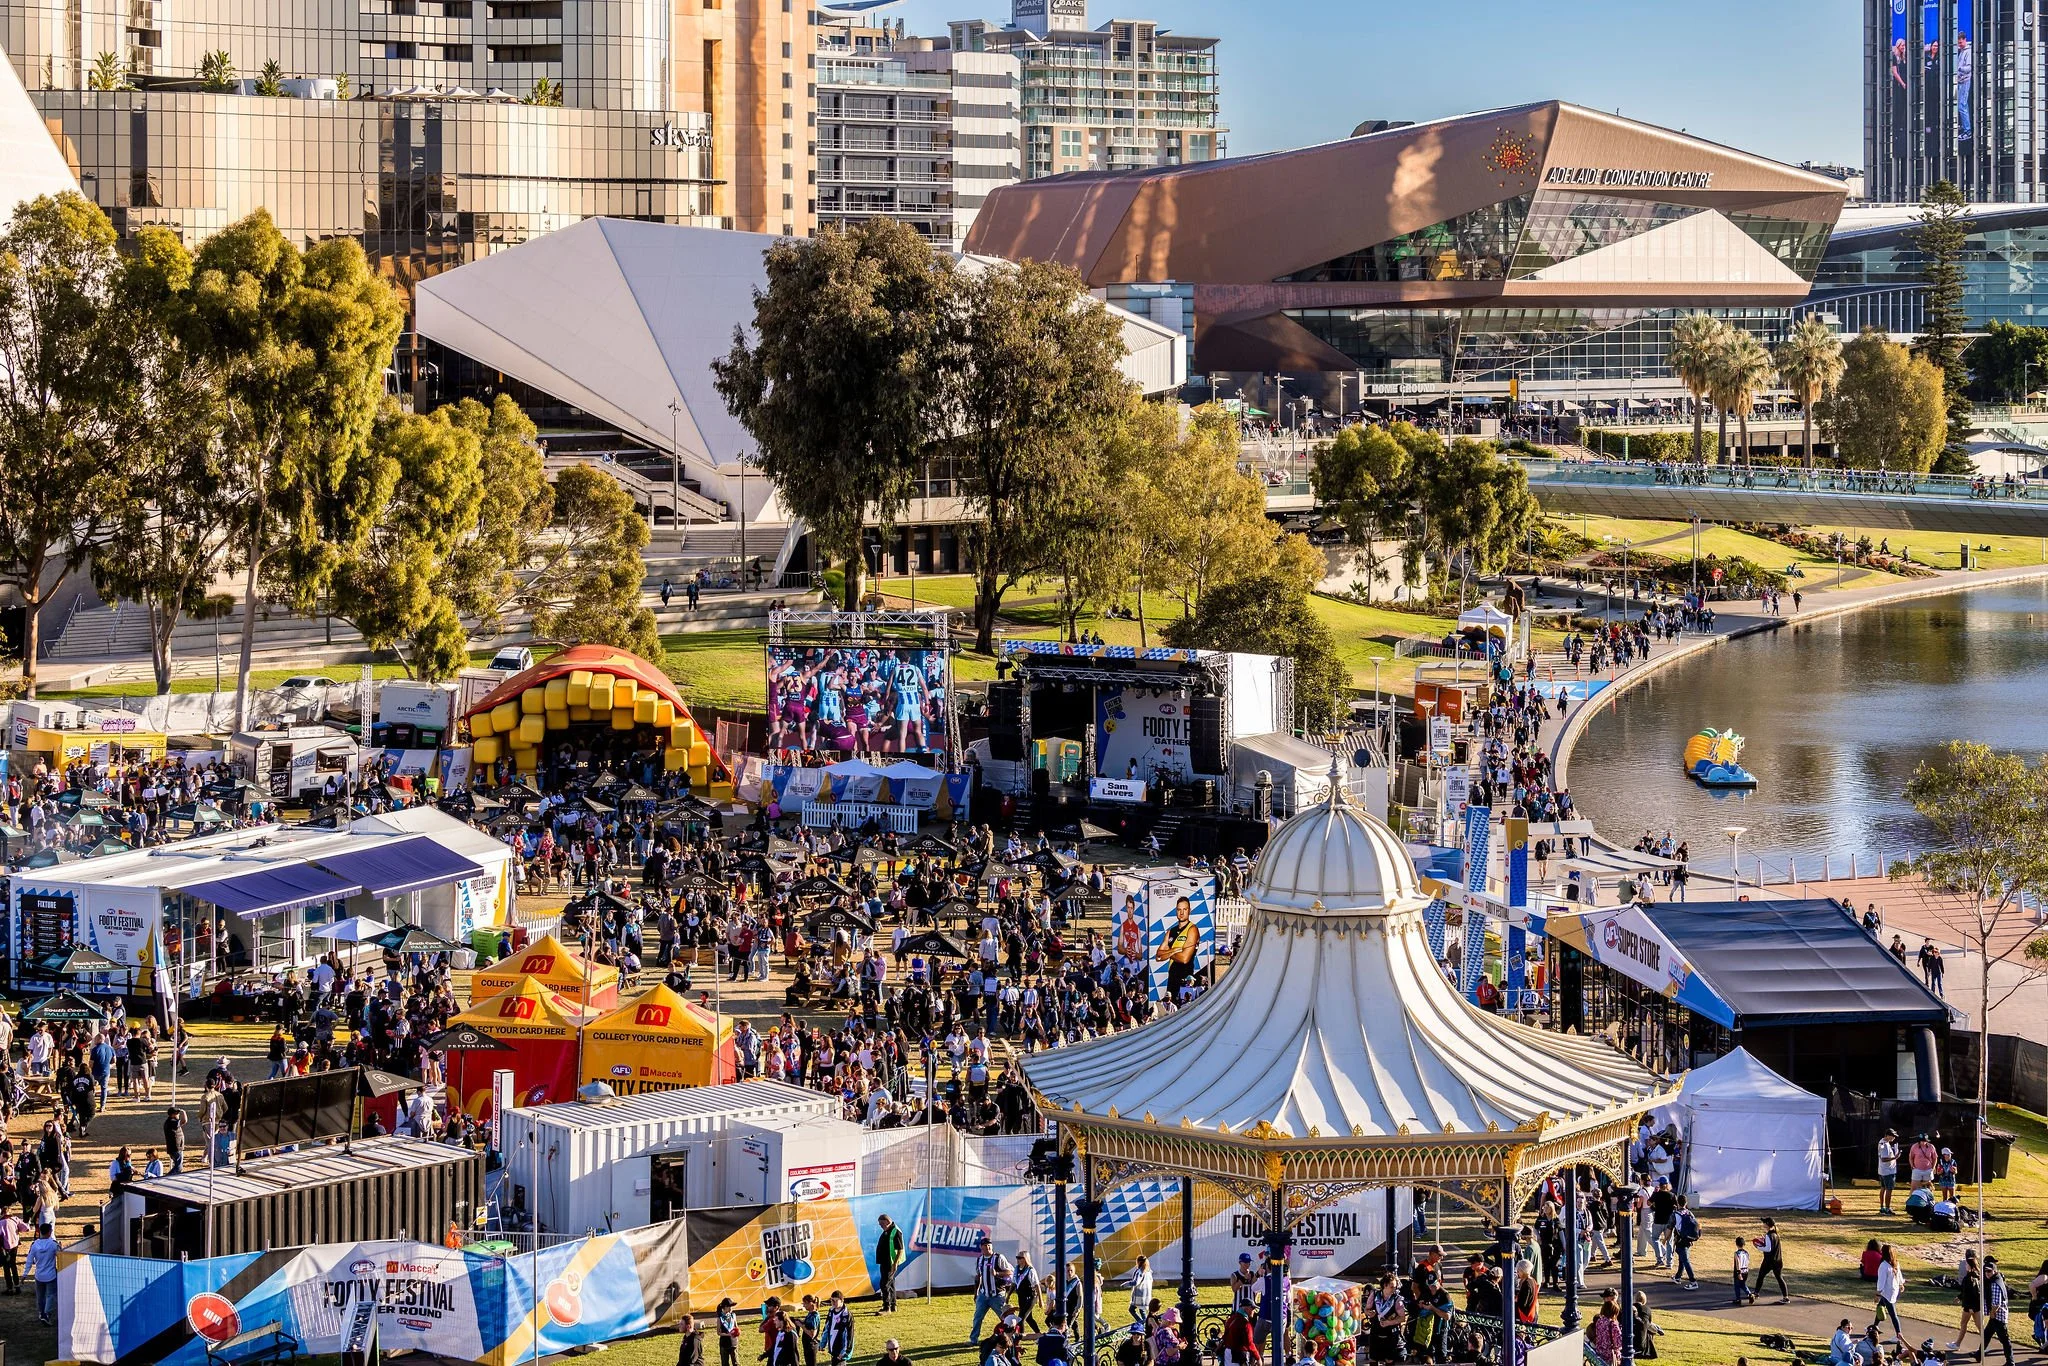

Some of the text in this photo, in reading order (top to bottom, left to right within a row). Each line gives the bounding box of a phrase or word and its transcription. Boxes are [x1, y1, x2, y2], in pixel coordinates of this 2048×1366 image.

[1546, 166, 1714, 189] ADELAIDE CONVENTION CENTRE
[1371, 383, 1436, 394] HOME GROUND
[786, 674, 803, 693] 23
[897, 668, 915, 687] 42
[1160, 704, 1175, 714] AFL
[1143, 716, 1180, 738] FOOTY
[1154, 737, 1191, 746] GATHER
[1102, 788, 1134, 797] Lavers
[1107, 782, 1128, 791] Sam
[37, 900, 57, 909] FIXTURE
[99, 915, 144, 929] FOOTY FESTIVAL
[1605, 924, 1661, 972] AFL SUPER STORE
[480, 978, 581, 993] COLLECT ARD HERE
[1525, 993, 1537, 1003] 20
[494, 1026, 518, 1035] YOUR
[519, 1027, 543, 1036] CARD
[544, 1027, 567, 1036] HERE
[592, 1031, 704, 1047] COLLECT YOUR CARD HERE
[612, 1066, 683, 1079] AFL Macca's
[591, 1078, 635, 1097] OTY
[1232, 1212, 1361, 1239] FOO ESTIVAL
[762, 1222, 811, 1250] GATHER
[915, 1222, 980, 1248] ADELAIDE
[1248, 1237, 1346, 1247] GAR ROUND
[765, 1241, 809, 1268] ROUND
[353, 1262, 438, 1275] AFL Macca's
[766, 1265, 786, 1286] IT!
[323, 1278, 456, 1312] FOOTY FESTIVAL
[398, 1306, 443, 1319] ROUND
